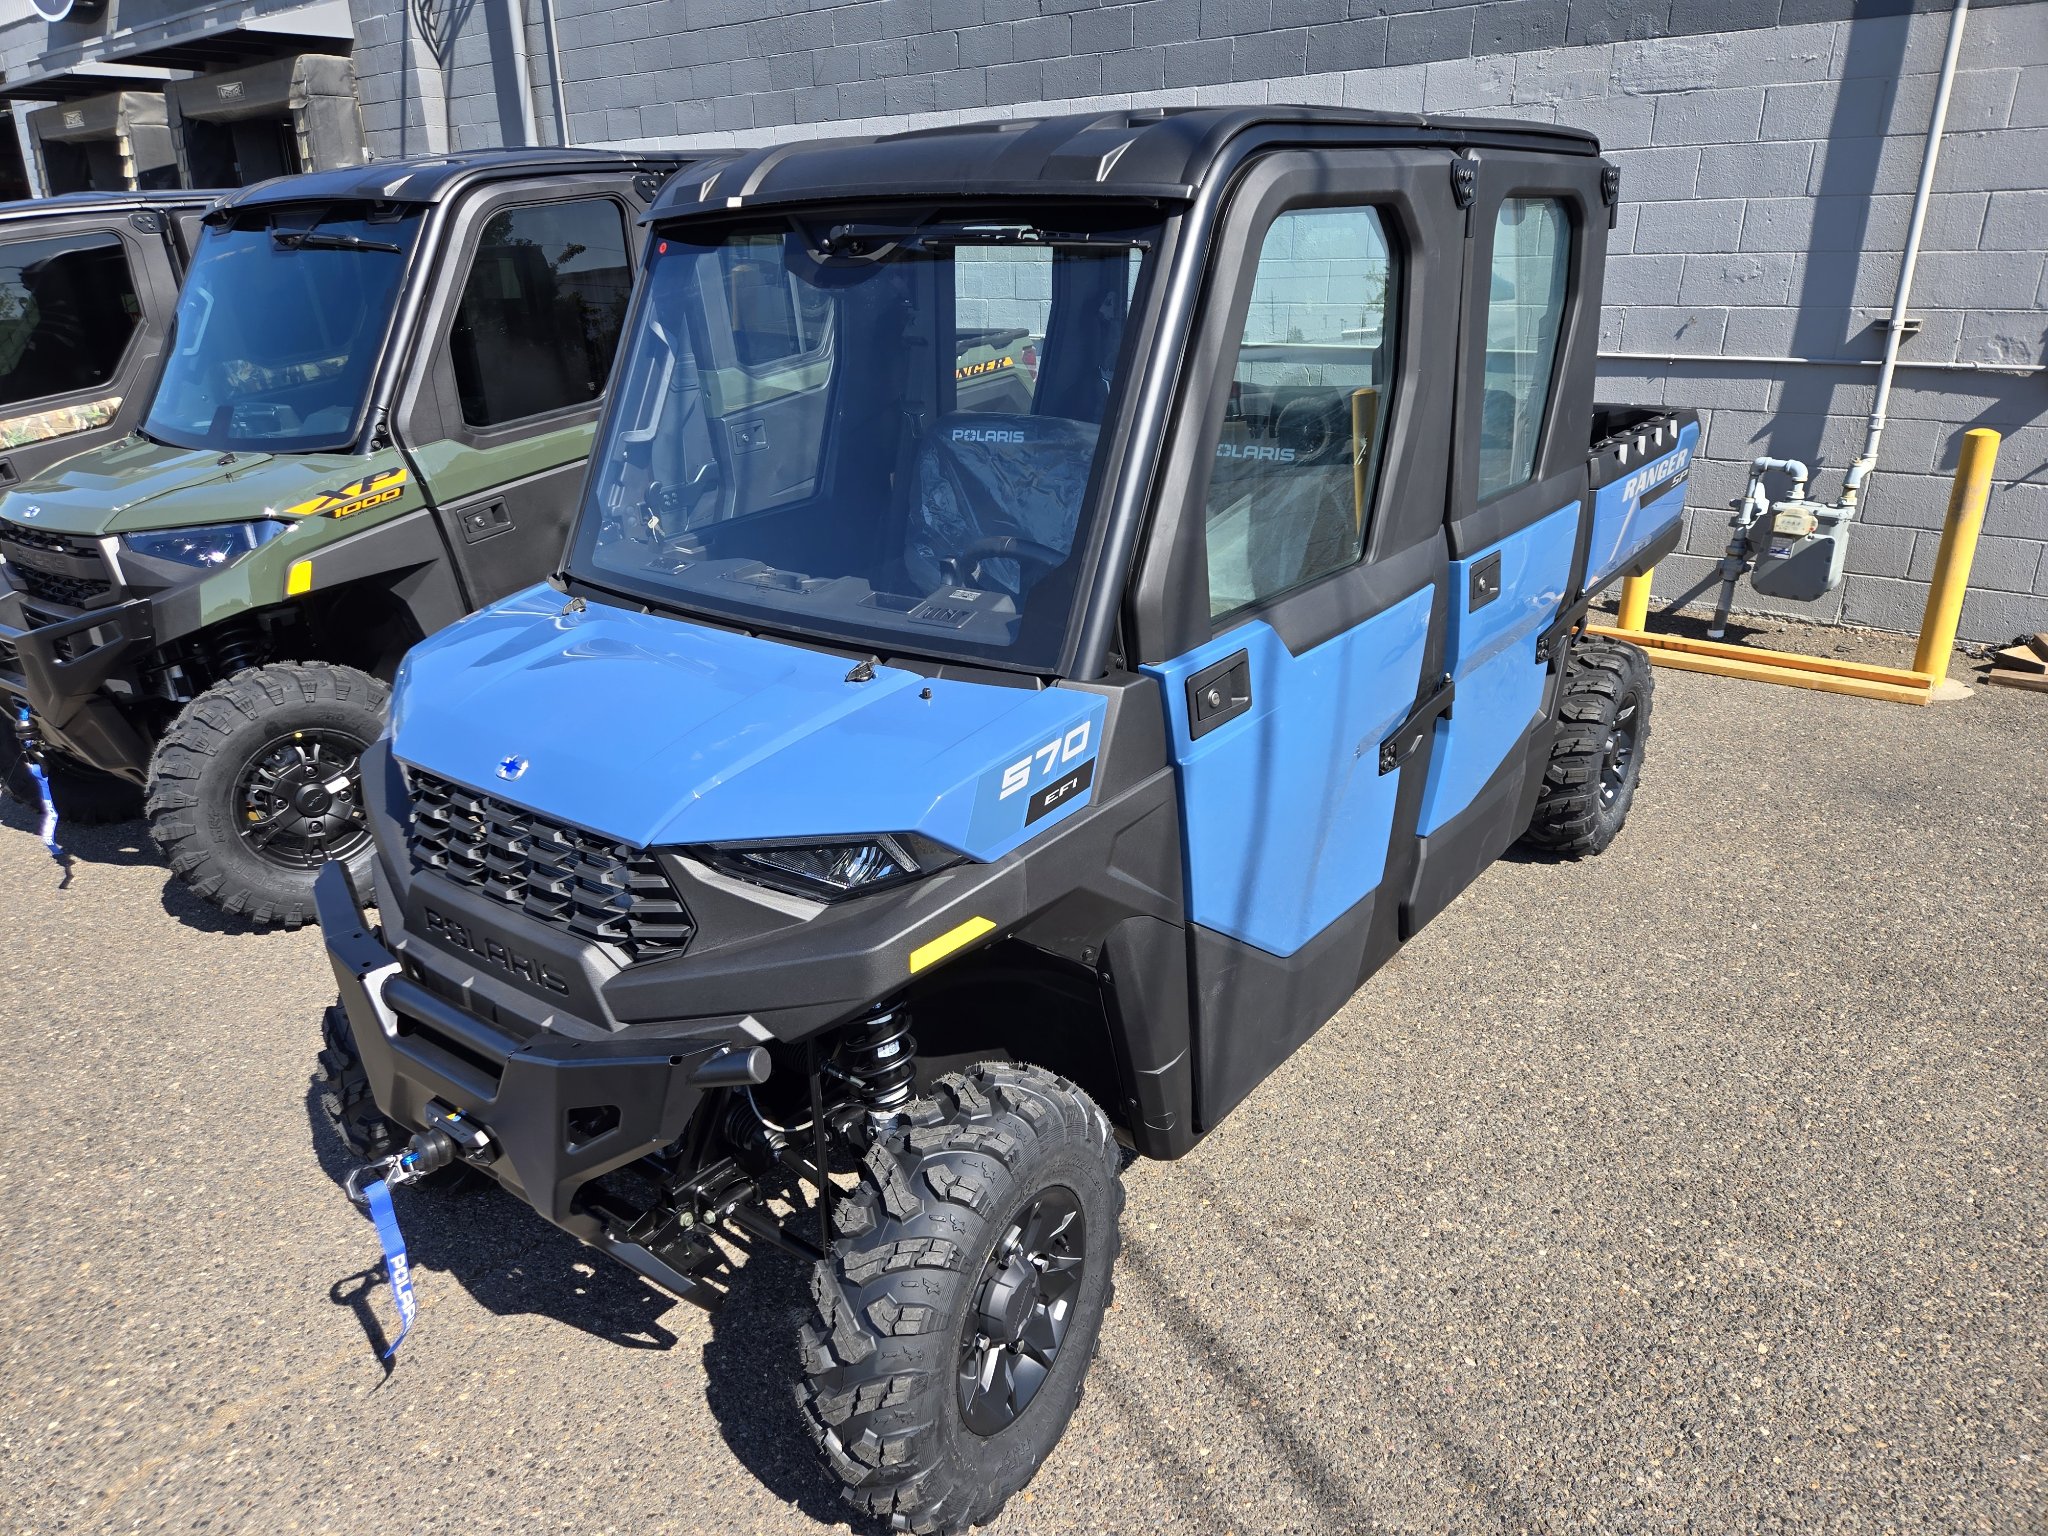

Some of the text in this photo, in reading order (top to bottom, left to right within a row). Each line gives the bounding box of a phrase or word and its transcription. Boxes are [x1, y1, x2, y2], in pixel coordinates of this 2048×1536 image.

[952, 429, 1025, 443] POLARIS
[1216, 443, 1296, 462] OLARIS
[311, 467, 402, 512] XP
[1622, 448, 1688, 503] RANGER
[1671, 469, 1689, 488] SP
[333, 487, 401, 518] 1000
[999, 720, 1091, 801] 570
[1044, 777, 1078, 806] EFI
[424, 906, 570, 998] POLARIS
[390, 1252, 416, 1337] POLARI
